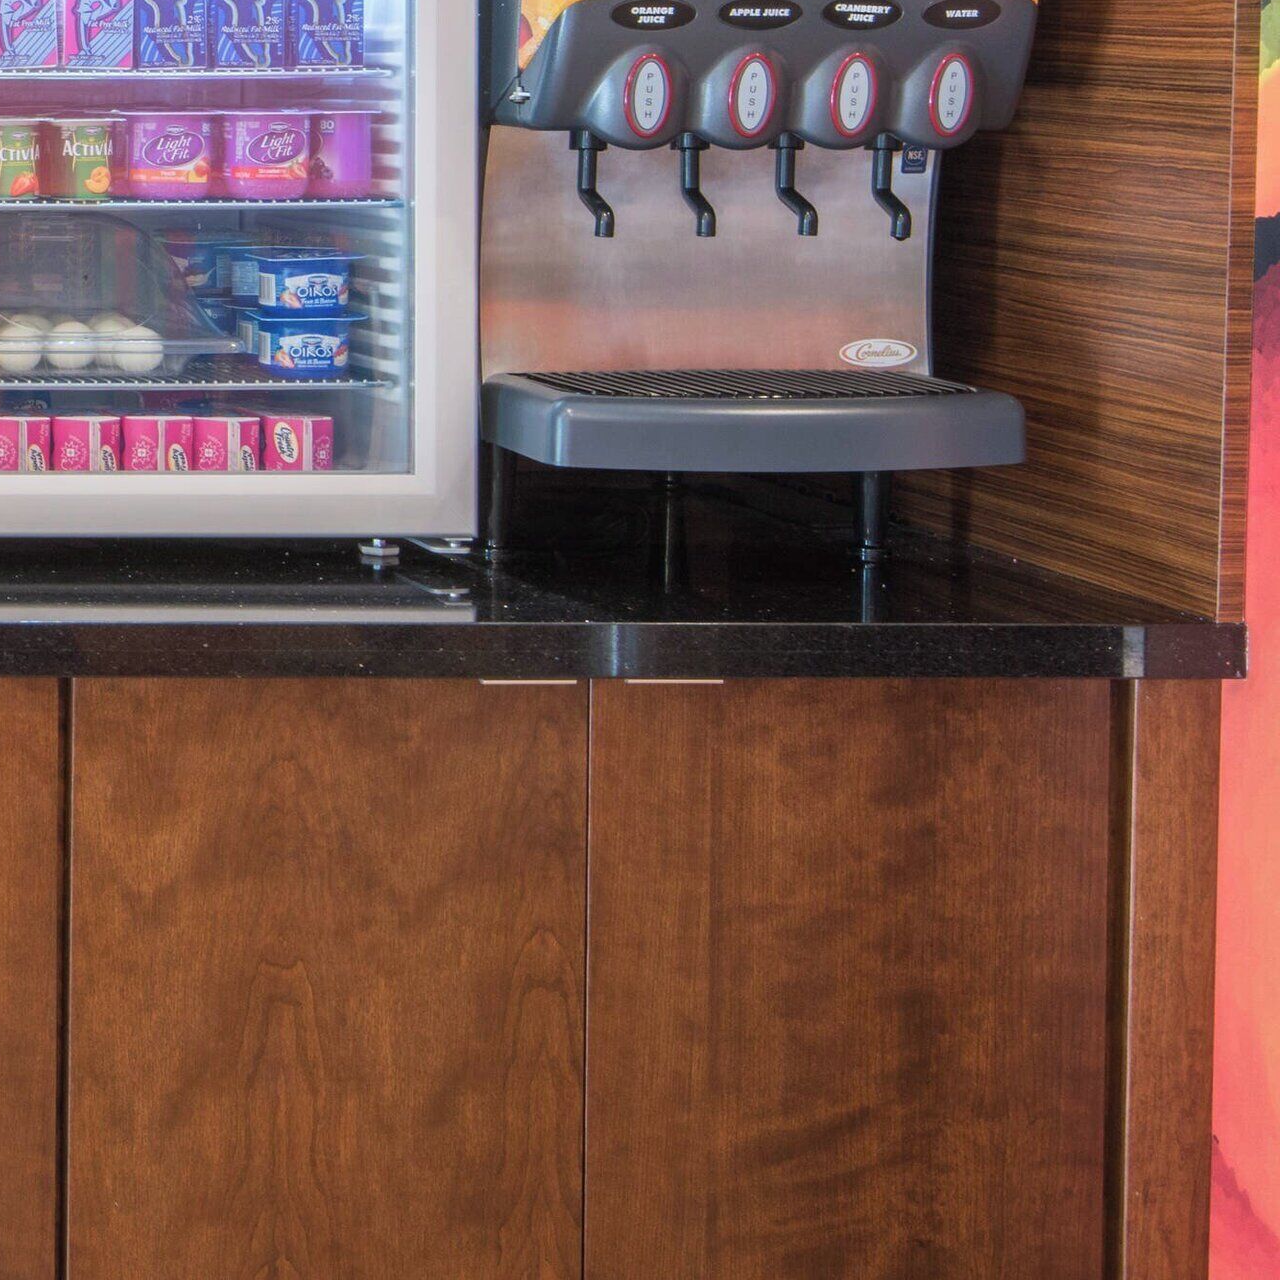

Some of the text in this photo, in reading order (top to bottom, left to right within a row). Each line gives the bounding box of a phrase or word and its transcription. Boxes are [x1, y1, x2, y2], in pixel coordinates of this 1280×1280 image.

[631, 6, 674, 15] ORANGE
[730, 7, 791, 17] APPLE JUICE
[835, 4, 891, 15] CRANBERRY
[946, 10, 979, 18] WATER
[637, 15, 665, 24] JUICE
[848, 13, 875, 23] JUICE
[644, 72, 655, 119] PUSH
[746, 72, 758, 119] PUSH
[848, 72, 860, 119] PUSH
[946, 71, 959, 119] PUSH
[156, 135, 191, 152] Light
[261, 132, 295, 150] Light
[62, 139, 113, 157] ACTIVIA
[907, 150, 924, 161] NSF
[297, 285, 338, 298] OIKOS
[290, 346, 333, 358] OIKOS
